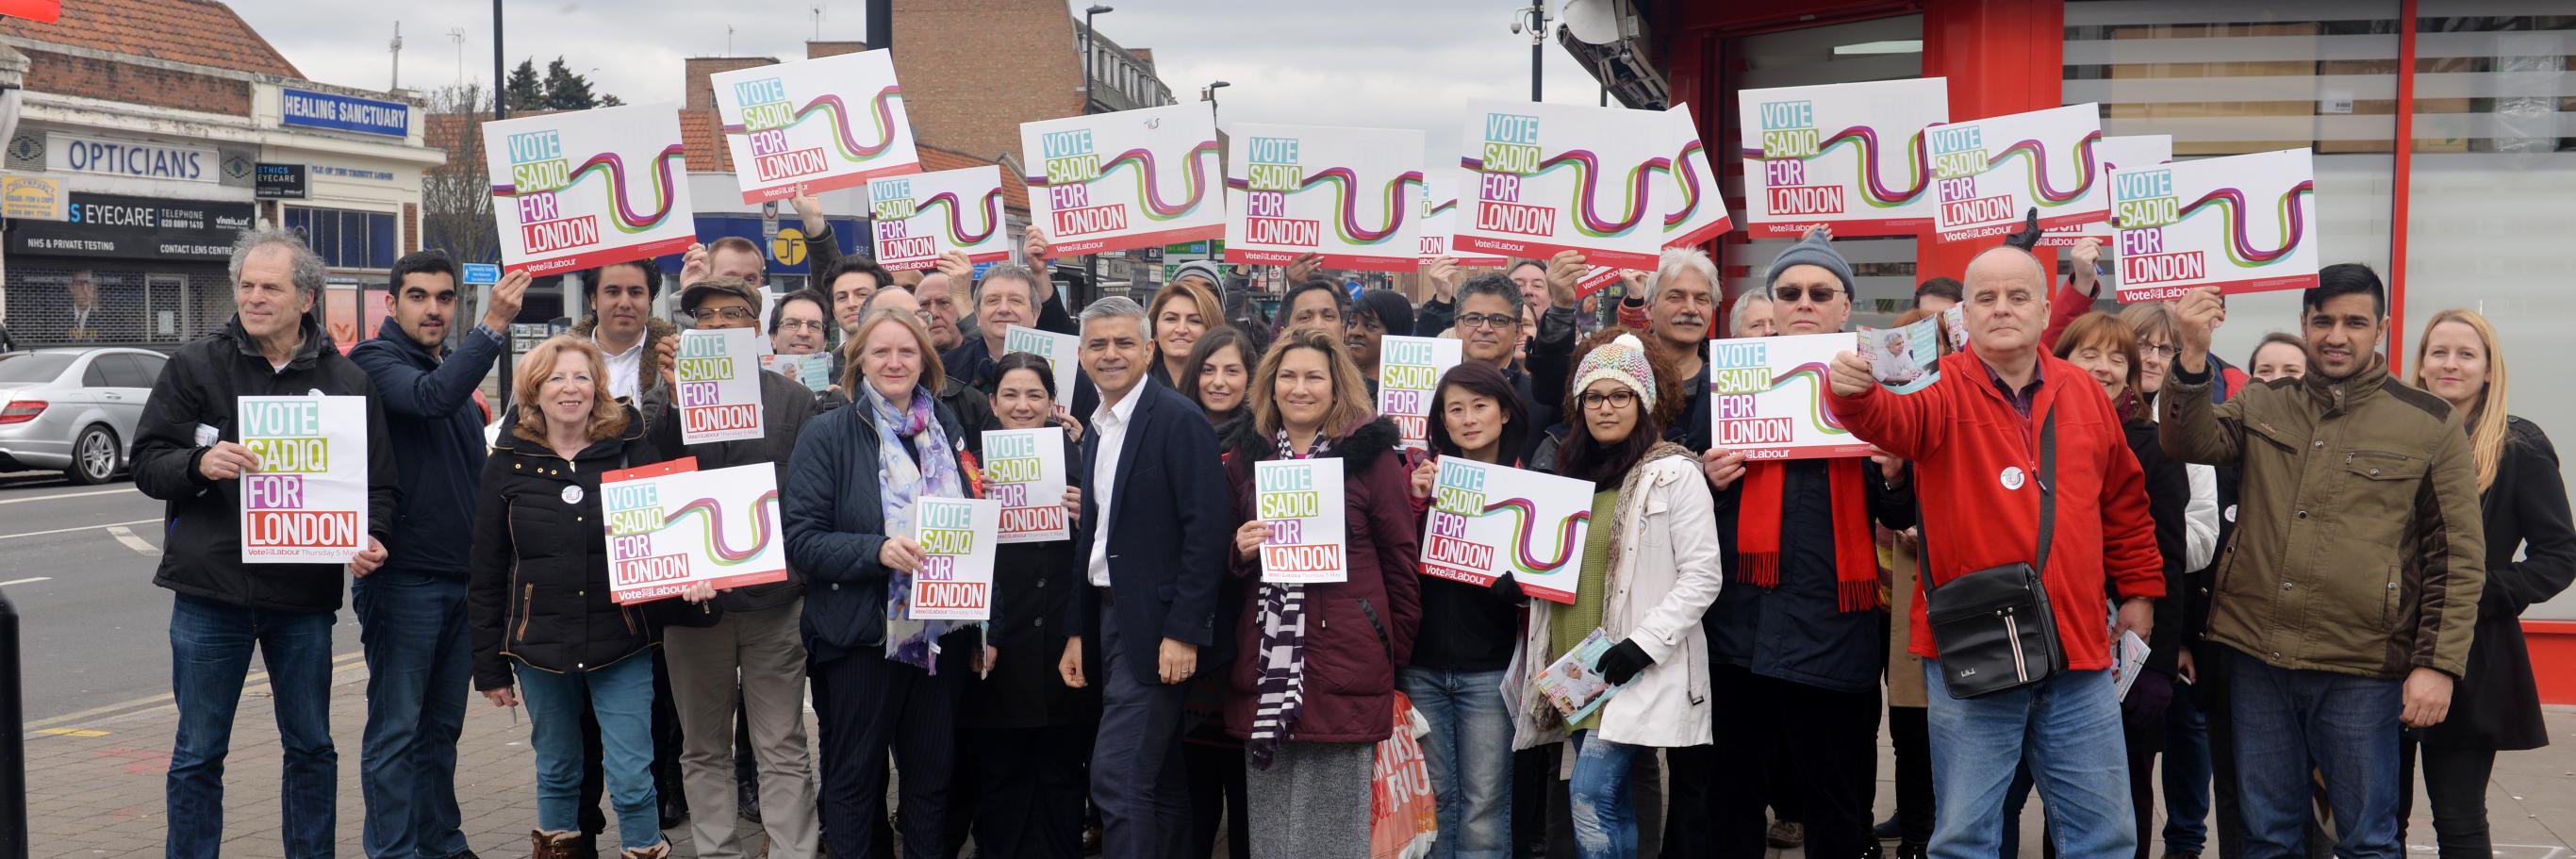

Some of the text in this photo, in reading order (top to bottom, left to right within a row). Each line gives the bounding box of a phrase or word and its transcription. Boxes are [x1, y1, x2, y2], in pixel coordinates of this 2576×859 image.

[736, 79, 784, 106] VOTE
[285, 95, 405, 129] HEALING SANCTUARY
[742, 103, 795, 130] SADIQ
[1762, 102, 1811, 128] VOTE
[1488, 114, 1537, 142] VOTE
[1934, 126, 1980, 153] VOTE
[510, 131, 561, 161] VOTE
[751, 130, 785, 155] FOR
[1044, 130, 1092, 157] VOTE
[1250, 138, 1296, 163] VOTE
[1764, 130, 1819, 157] SADIQ
[69, 140, 200, 178] OPTICIANS
[757, 149, 826, 181] LONDON
[1048, 156, 1100, 183] SADIQ
[1484, 144, 1539, 173] SADIQ
[1938, 150, 1989, 176] SADIQ
[514, 160, 570, 192] SADIQ
[1249, 165, 1301, 190] SADIQ
[1767, 159, 1803, 185] FOR
[764, 184, 808, 197] Vote Laur
[874, 179, 909, 199] VOTE
[1051, 185, 1086, 209] FOR
[1482, 173, 1518, 201] FOR
[1940, 177, 1974, 202] FOR
[2119, 171, 2170, 199] VOTE
[520, 192, 557, 223] FOR
[876, 199, 916, 220] SADIQ
[1248, 192, 1283, 216] FOR
[1769, 187, 1841, 214] LONDON
[1942, 196, 2012, 226] LONDON
[2121, 197, 2178, 227] SADIQ
[86, 205, 154, 227] EYECARE
[162, 209, 203, 220] TELEPHONE
[1054, 206, 1125, 236] LONDON
[1478, 203, 1553, 235] LONDON
[523, 217, 598, 254] LONDON
[879, 221, 905, 240] FOR
[1247, 220, 1317, 245] LONDON
[1944, 225, 2012, 241] Vote Labour
[2122, 228, 2161, 256] FOR
[28, 239, 114, 251] NHS & PRIVATE TESTING
[160, 244, 190, 254] CONTACT
[208, 247, 233, 256] CENTRE
[882, 238, 933, 260] LONDON
[1079, 241, 1104, 250] Labour
[1419, 238, 1442, 254] DON
[1475, 240, 1524, 251] Vote Labour
[527, 258, 576, 273] Vote Labour
[2125, 253, 2203, 284] LONDON
[1583, 281, 1596, 289] Vote
[2124, 288, 2193, 301] Vote Labo
[679, 335, 724, 356] VOTE
[1011, 330, 1052, 356] VOTE
[1387, 341, 1432, 364] VOTE
[1719, 344, 1765, 367] VOTE
[680, 358, 733, 380] SADIQ
[1385, 365, 1436, 388] SADIQ
[1719, 370, 1771, 392] SADIQ
[683, 382, 718, 406] FOR
[1384, 391, 1416, 413] FOR
[1720, 395, 1754, 418] FOR
[245, 403, 317, 435] VOTE
[685, 405, 754, 432] LONDON
[1395, 417, 1426, 438] OND
[1720, 420, 1791, 443] LONDON
[247, 439, 324, 471] SADIQ
[988, 436, 1033, 457] VOTE
[1752, 450, 1790, 458] Labour
[990, 458, 1040, 482] SADIQ
[1262, 466, 1311, 490] VOTE
[1443, 463, 1485, 490] VOTE
[249, 476, 301, 508] FOR
[609, 484, 657, 510] VOTE
[1263, 492, 1317, 517] SADIQ
[1438, 487, 1484, 516] SADIQ
[612, 507, 664, 535] SADIQ
[924, 504, 970, 527] VOTE
[999, 507, 1061, 532] ONDON
[1434, 512, 1464, 538] FOR
[250, 513, 354, 545] LONDON
[922, 530, 972, 553] SADIQ
[615, 535, 650, 559] FOR
[1267, 546, 1338, 570] LONDON
[1429, 537, 1492, 570] LONDON
[618, 554, 688, 585] LONDON
[1426, 565, 1486, 585] Vote Labour
[619, 585, 687, 601] Vote Labour
[917, 583, 984, 607] LONDON
